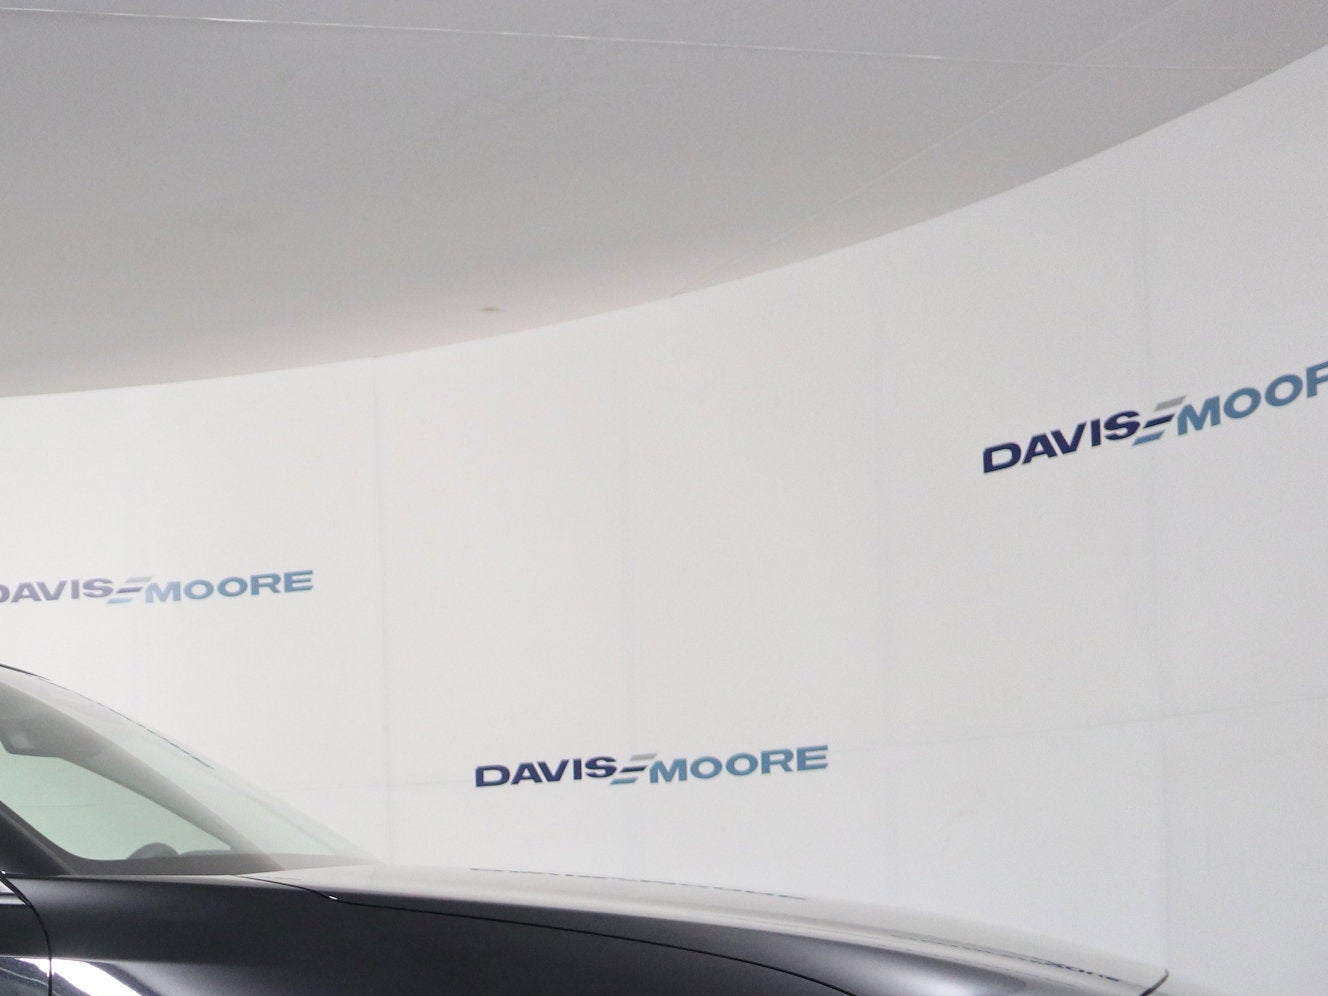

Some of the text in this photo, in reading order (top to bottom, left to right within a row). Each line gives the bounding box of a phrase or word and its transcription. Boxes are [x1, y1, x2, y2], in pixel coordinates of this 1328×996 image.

[982, 410, 1141, 474] DAVIS
[144, 569, 314, 604] MOORE
[475, 744, 829, 787] DAVIS MOORE
